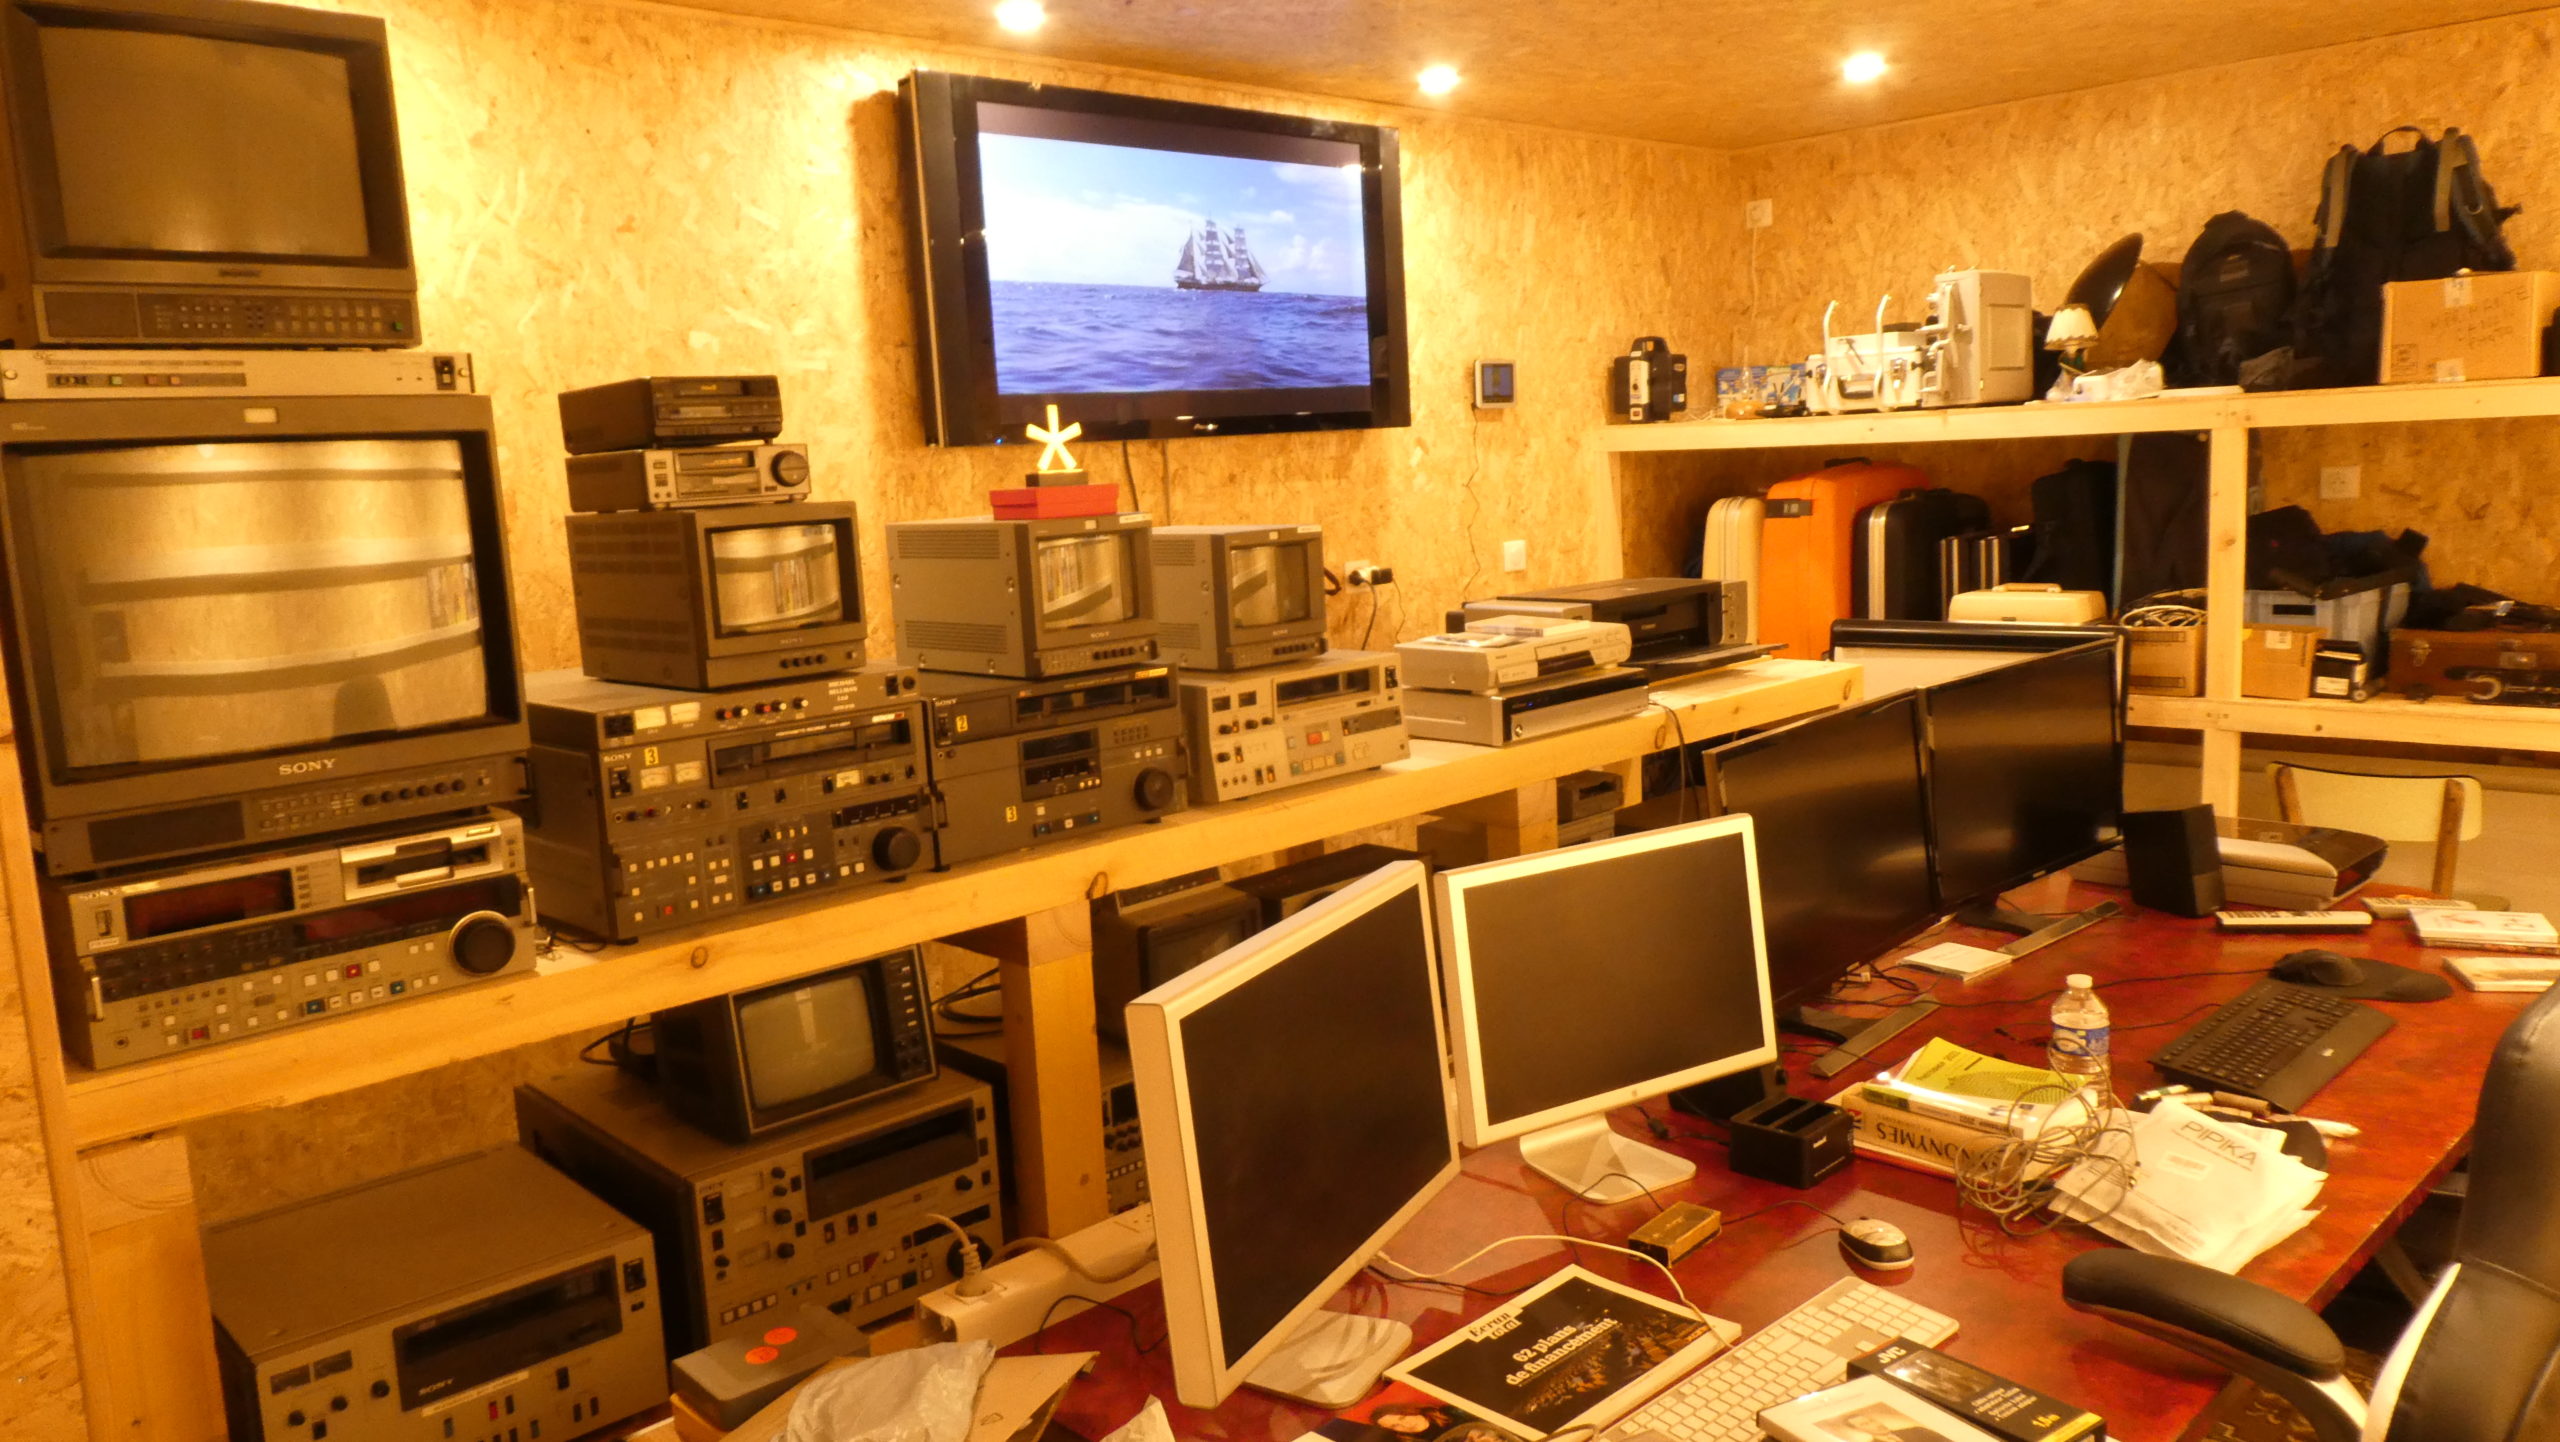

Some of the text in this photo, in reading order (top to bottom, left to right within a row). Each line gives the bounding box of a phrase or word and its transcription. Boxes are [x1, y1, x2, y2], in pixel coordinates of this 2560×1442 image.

[279, 758, 336, 776] SONY
[603, 752, 632, 763] SONY
[1876, 1121, 1999, 1172] NONYMES
[2180, 1120, 2257, 1166] PIPIKA
[1505, 1318, 1618, 1385] de financement
[1512, 1325, 1577, 1362] 62 plans
[1877, 1346, 1907, 1364] JVC
